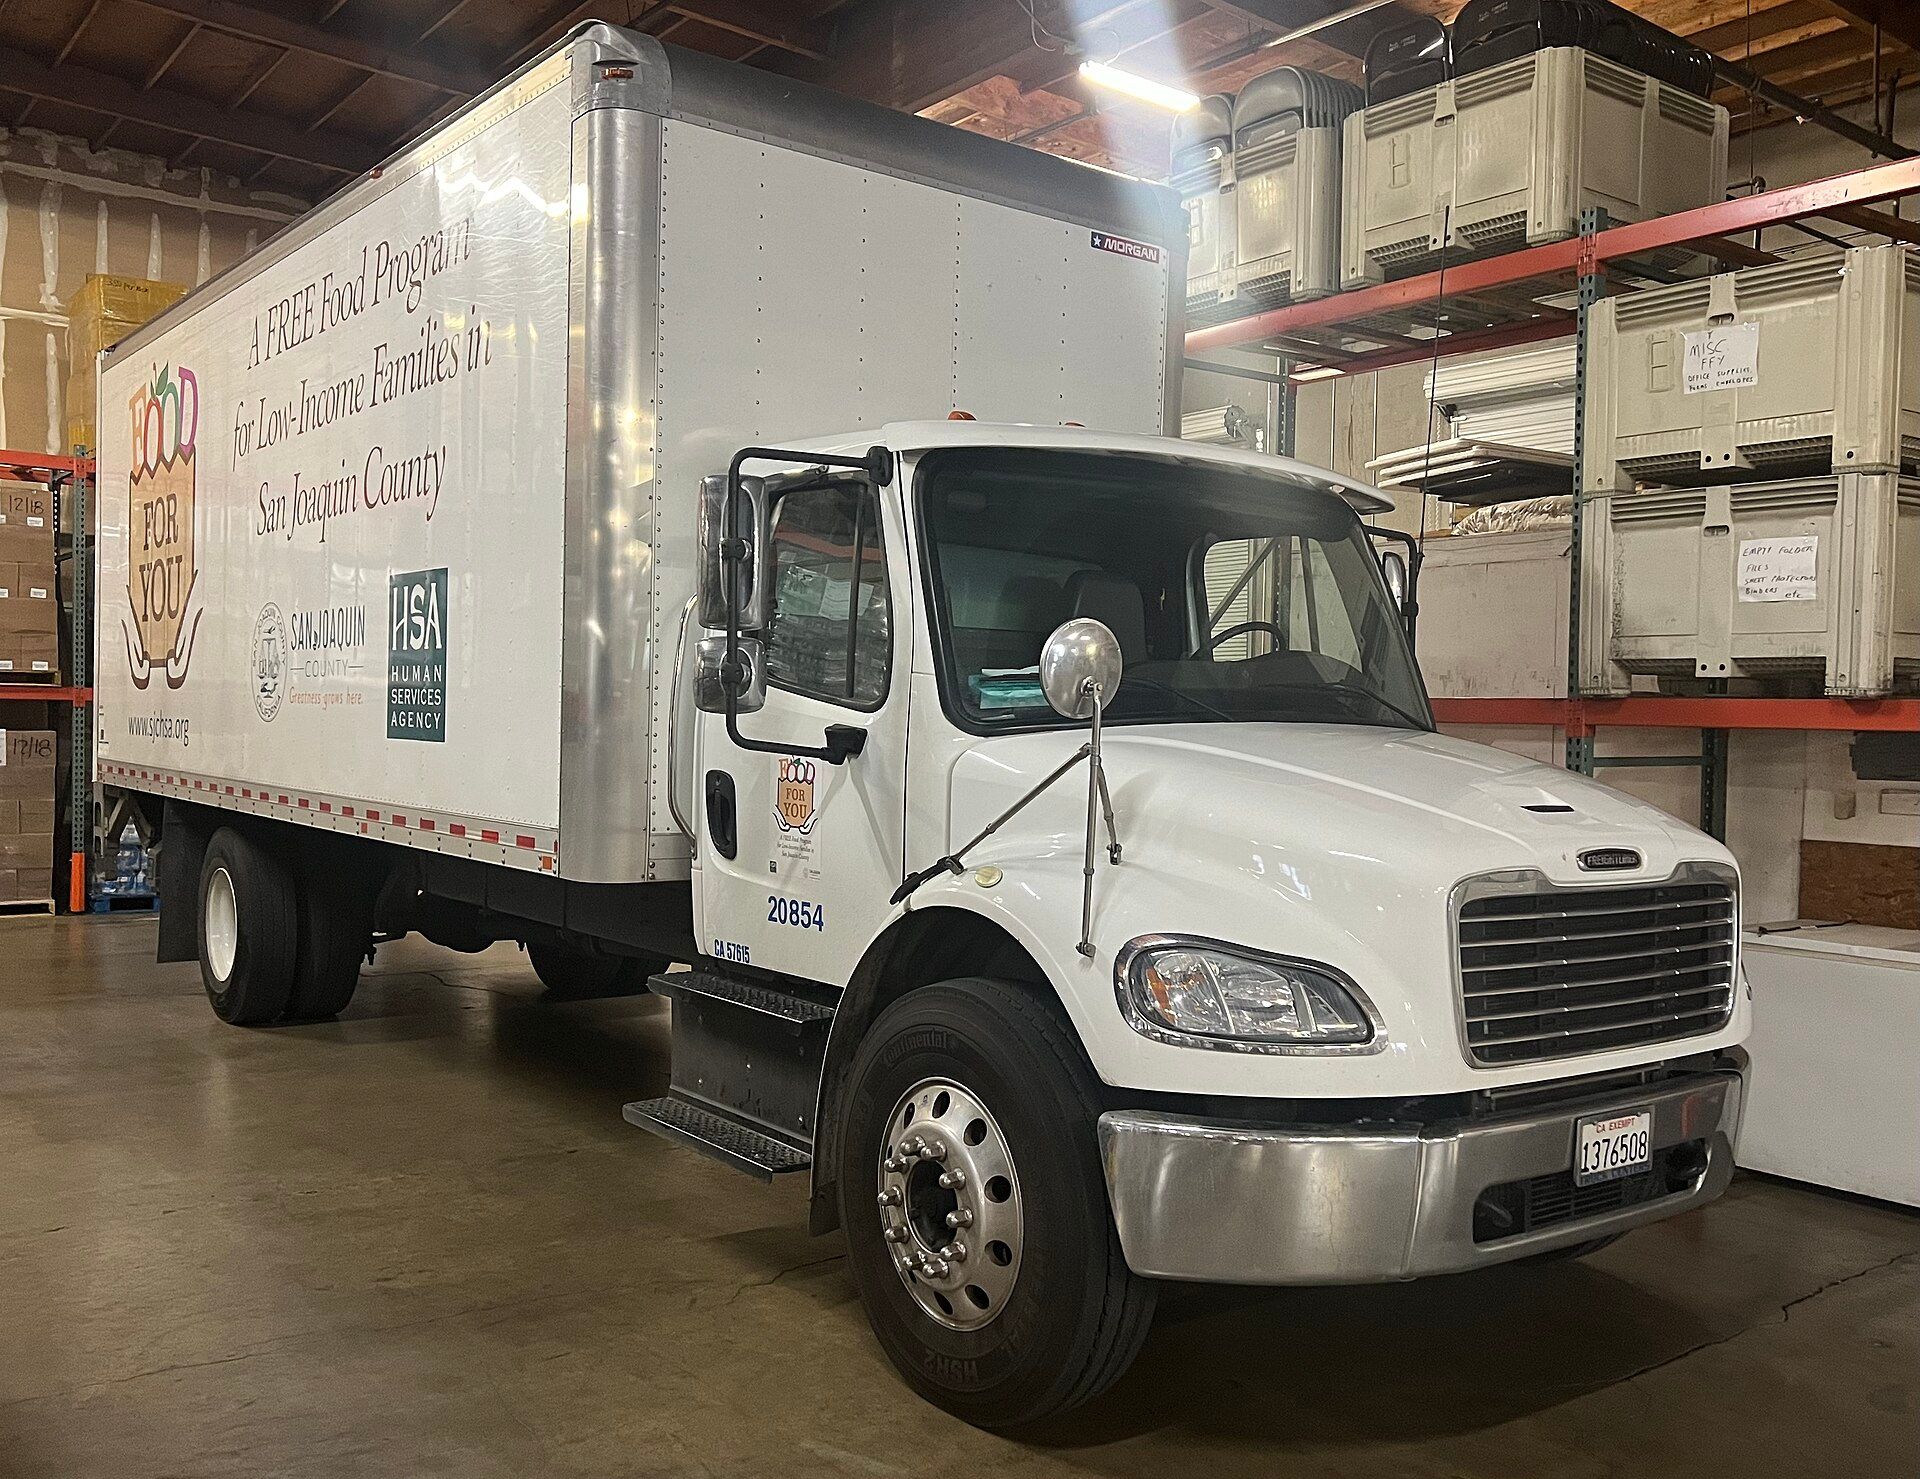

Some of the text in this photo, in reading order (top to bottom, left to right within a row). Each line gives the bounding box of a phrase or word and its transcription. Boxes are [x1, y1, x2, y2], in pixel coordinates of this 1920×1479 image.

[1104, 238, 1157, 260] MORGAN
[247, 217, 474, 370] A FREE Food Program
[1690, 339, 1727, 358] MISC
[1701, 355, 1725, 371] FFY
[232, 304, 493, 472] for Low-Income Families in
[1688, 373, 1710, 382] OFFICE
[129, 366, 198, 477] FOOD
[257, 444, 446, 543] San Joaquin County
[9, 495, 44, 515] 12/18
[143, 492, 179, 551] FOR
[1743, 545, 1814, 557] EMPTY FOLDER
[1746, 564, 1769, 573] FILES
[139, 555, 183, 622] YOU
[392, 583, 442, 650] HSA
[291, 612, 312, 651] SAN
[317, 605, 365, 653] JOAQUIN
[305, 659, 349, 678] COUNTY
[391, 665, 442, 683] HUMAN
[289, 687, 321, 705] Greatness
[391, 688, 442, 706] SERVICES
[128, 710, 190, 747] www.sjchsa.org
[391, 712, 442, 730] AGENCY
[13, 737, 52, 759] 12/18
[778, 757, 816, 783] FOOD
[786, 788, 805, 802] FOR
[784, 803, 808, 819] YOU
[767, 896, 825, 932] 20854
[714, 939, 750, 964] CA 57615
[1596, 1117, 1636, 1134] CA EXEMPT
[1580, 1130, 1648, 1173] 1376508
